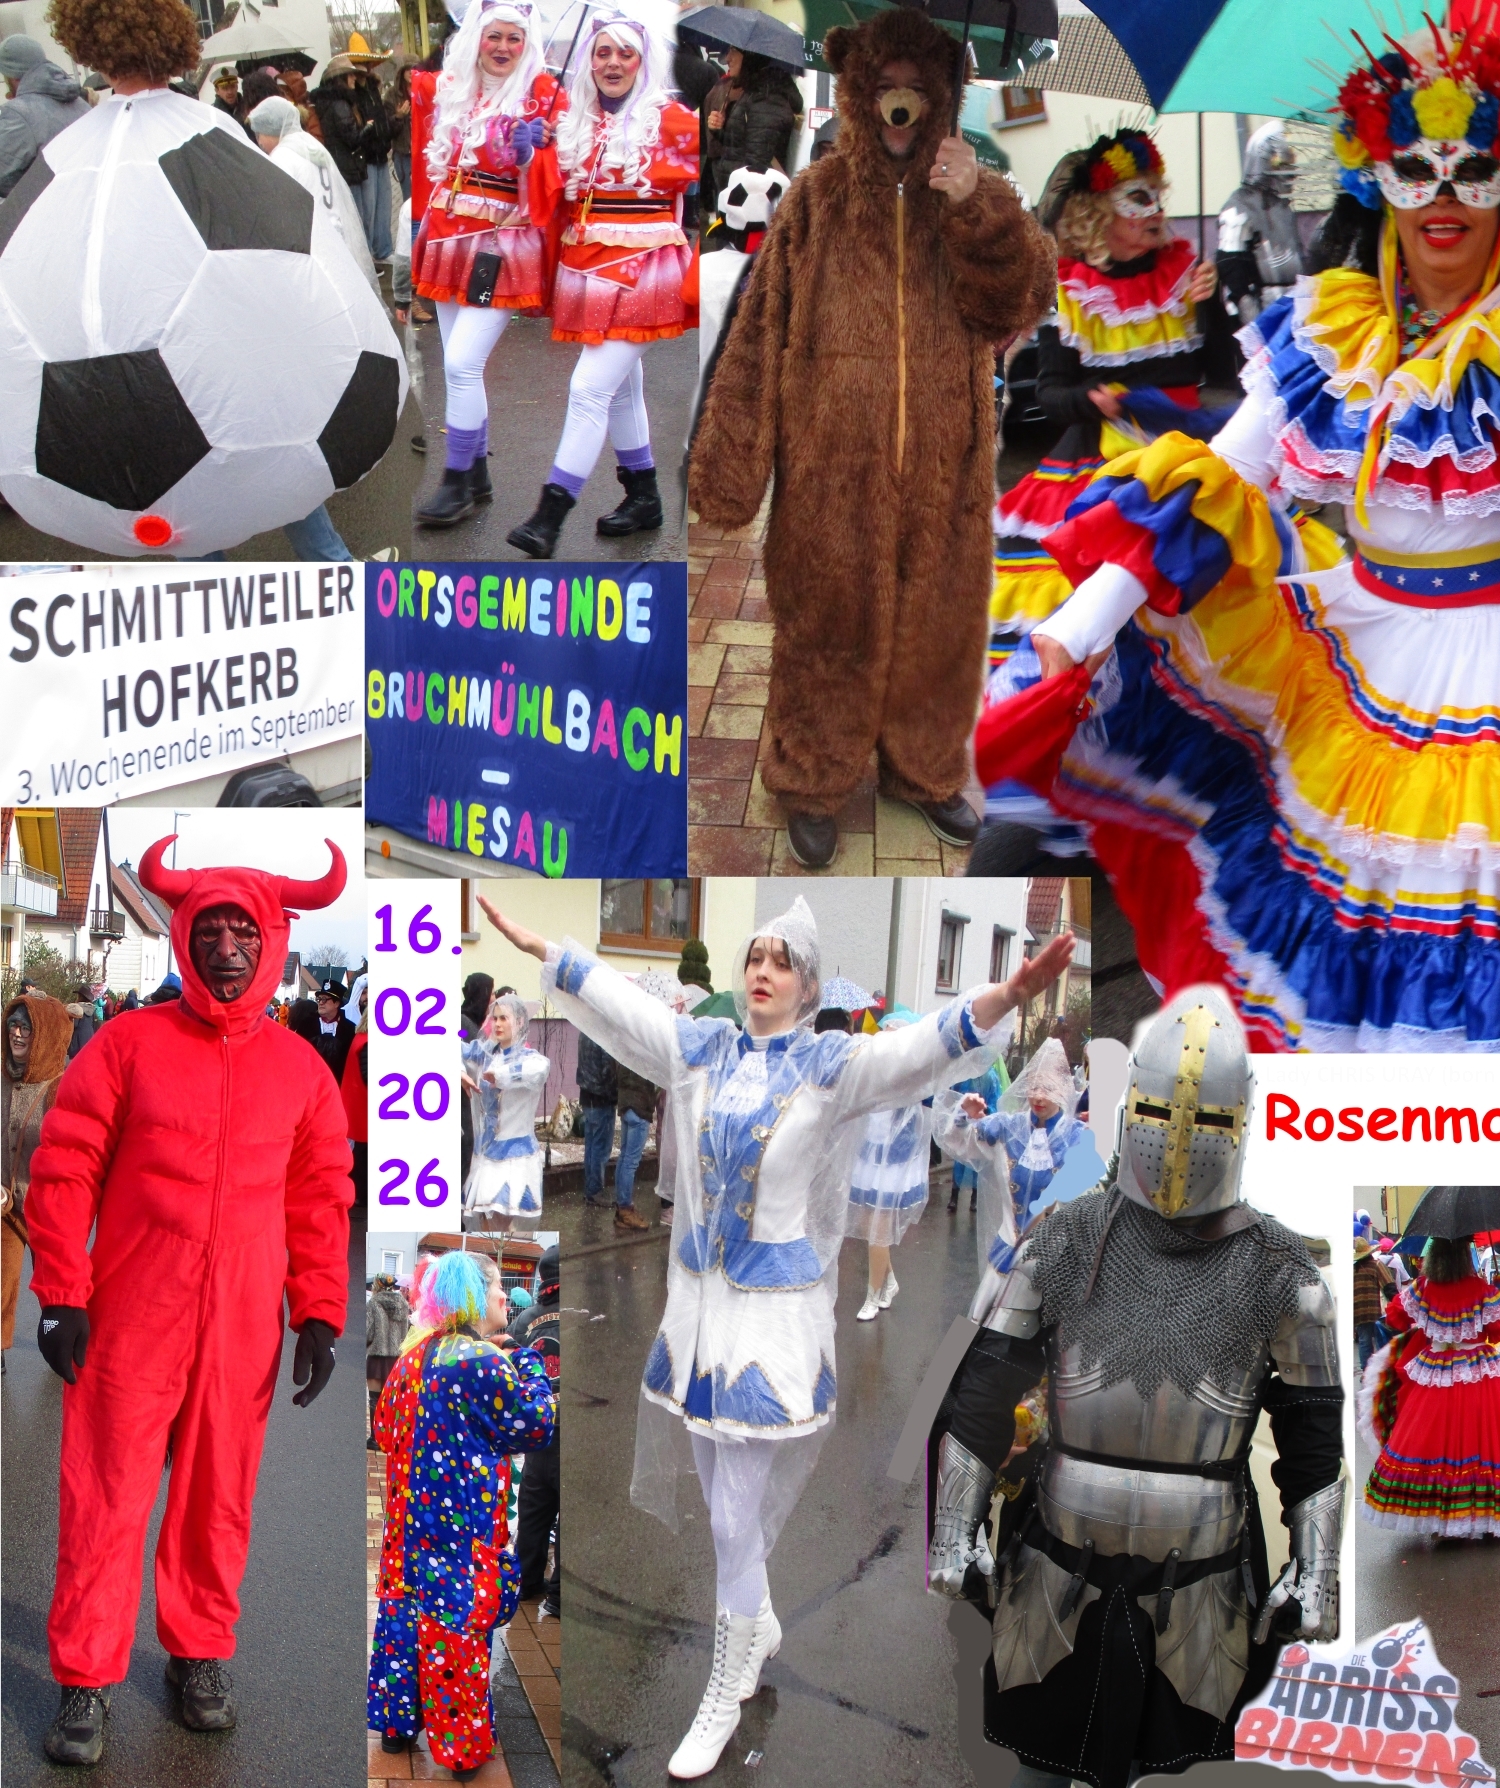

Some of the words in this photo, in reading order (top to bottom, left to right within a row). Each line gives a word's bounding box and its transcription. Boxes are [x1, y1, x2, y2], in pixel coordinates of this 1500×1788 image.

[8, 565, 356, 663] SCHMITTWEILER
[377, 569, 653, 644] ORTSGEMEINDE
[101, 646, 299, 738] HOFKERB
[368, 661, 683, 777] BRUCHMÜHLBACH
[17, 768, 44, 805] 3.
[51, 727, 213, 798] Wochenende
[217, 723, 247, 756] im
[251, 697, 356, 749] September
[427, 795, 568, 879] MIESAU
[1268, 1662, 1457, 1733] ABRISS
[1350, 1654, 1367, 1667] DIE
[1234, 1707, 1477, 1788] BIRNEN
